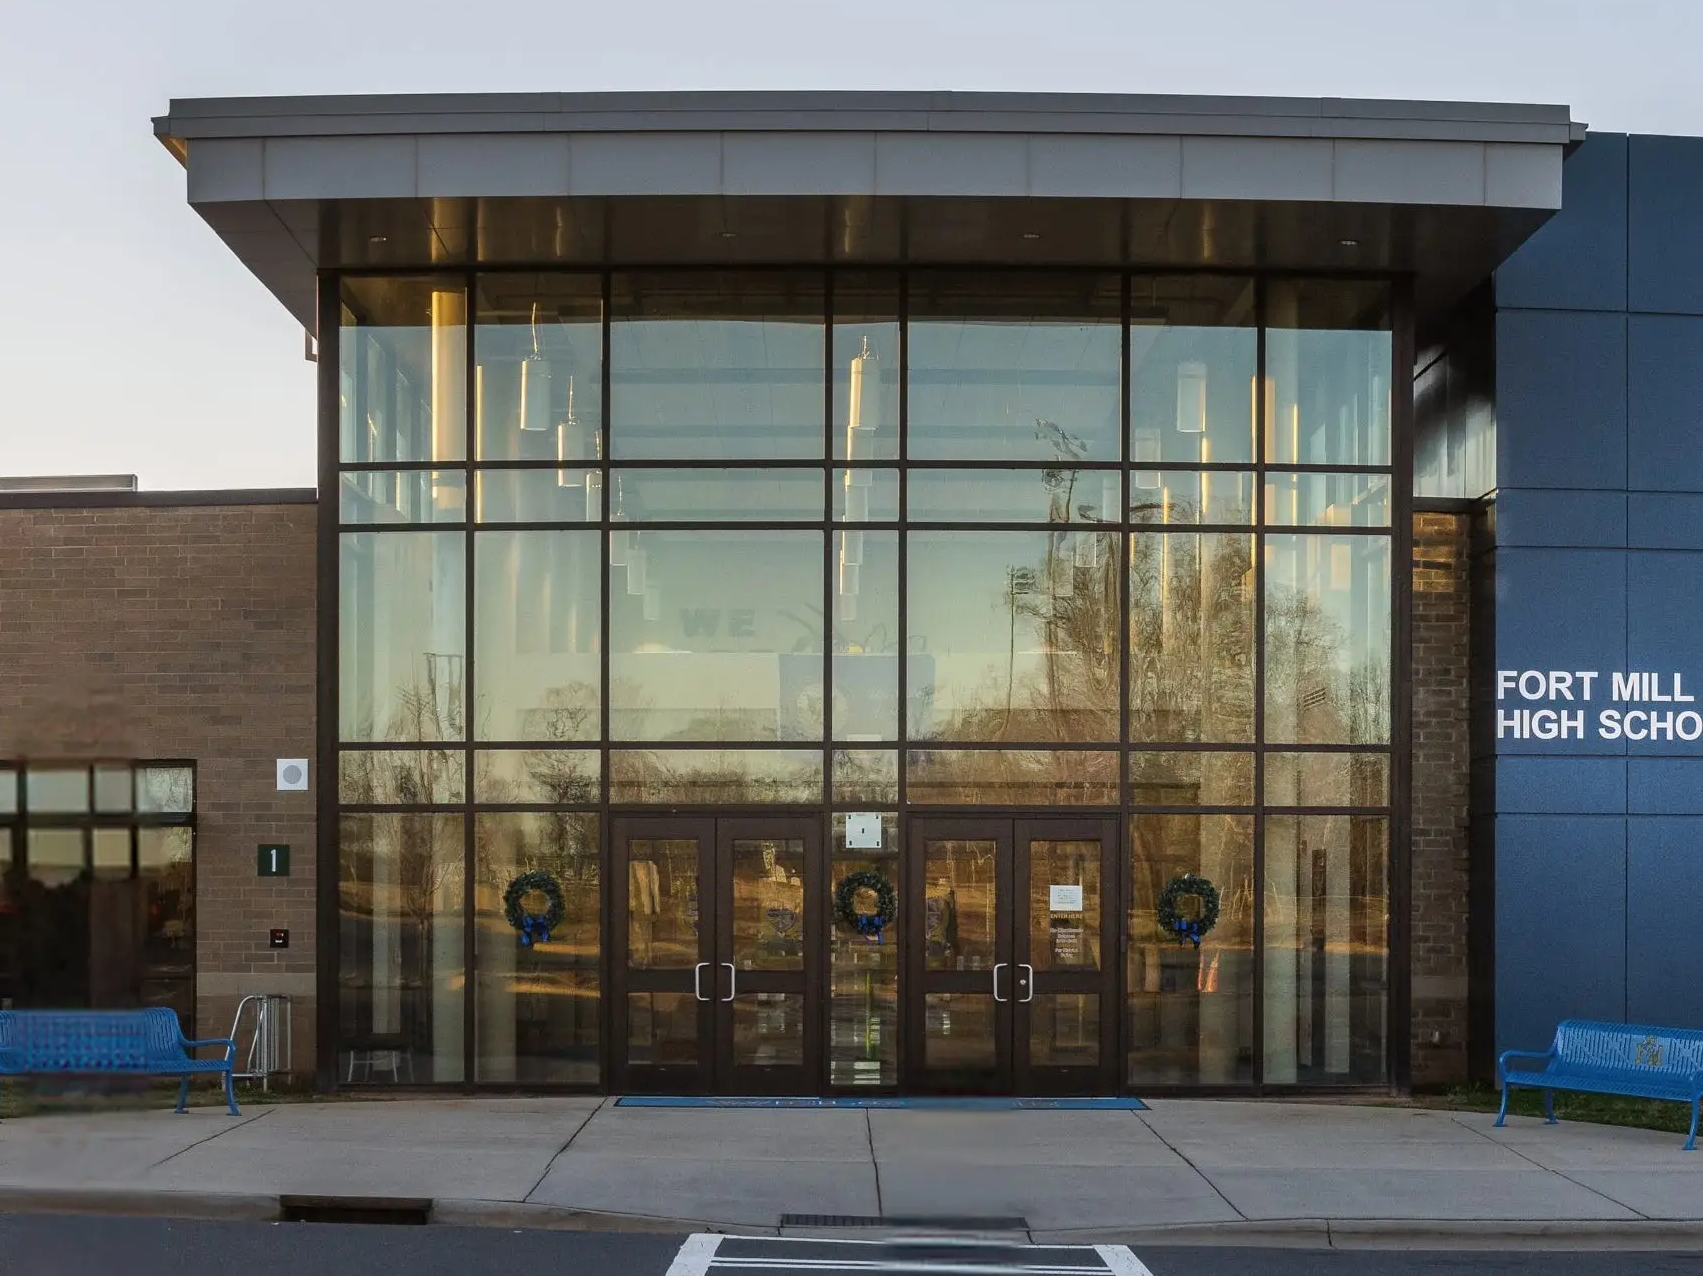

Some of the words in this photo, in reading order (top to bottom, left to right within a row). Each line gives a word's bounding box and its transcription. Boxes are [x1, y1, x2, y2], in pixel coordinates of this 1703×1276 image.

[679, 608, 756, 638] WE
[1497, 670, 1598, 701] FORT
[1612, 672, 1694, 702] MILL
[1497, 709, 1584, 739] HIGH
[270, 849, 277, 872] 1
